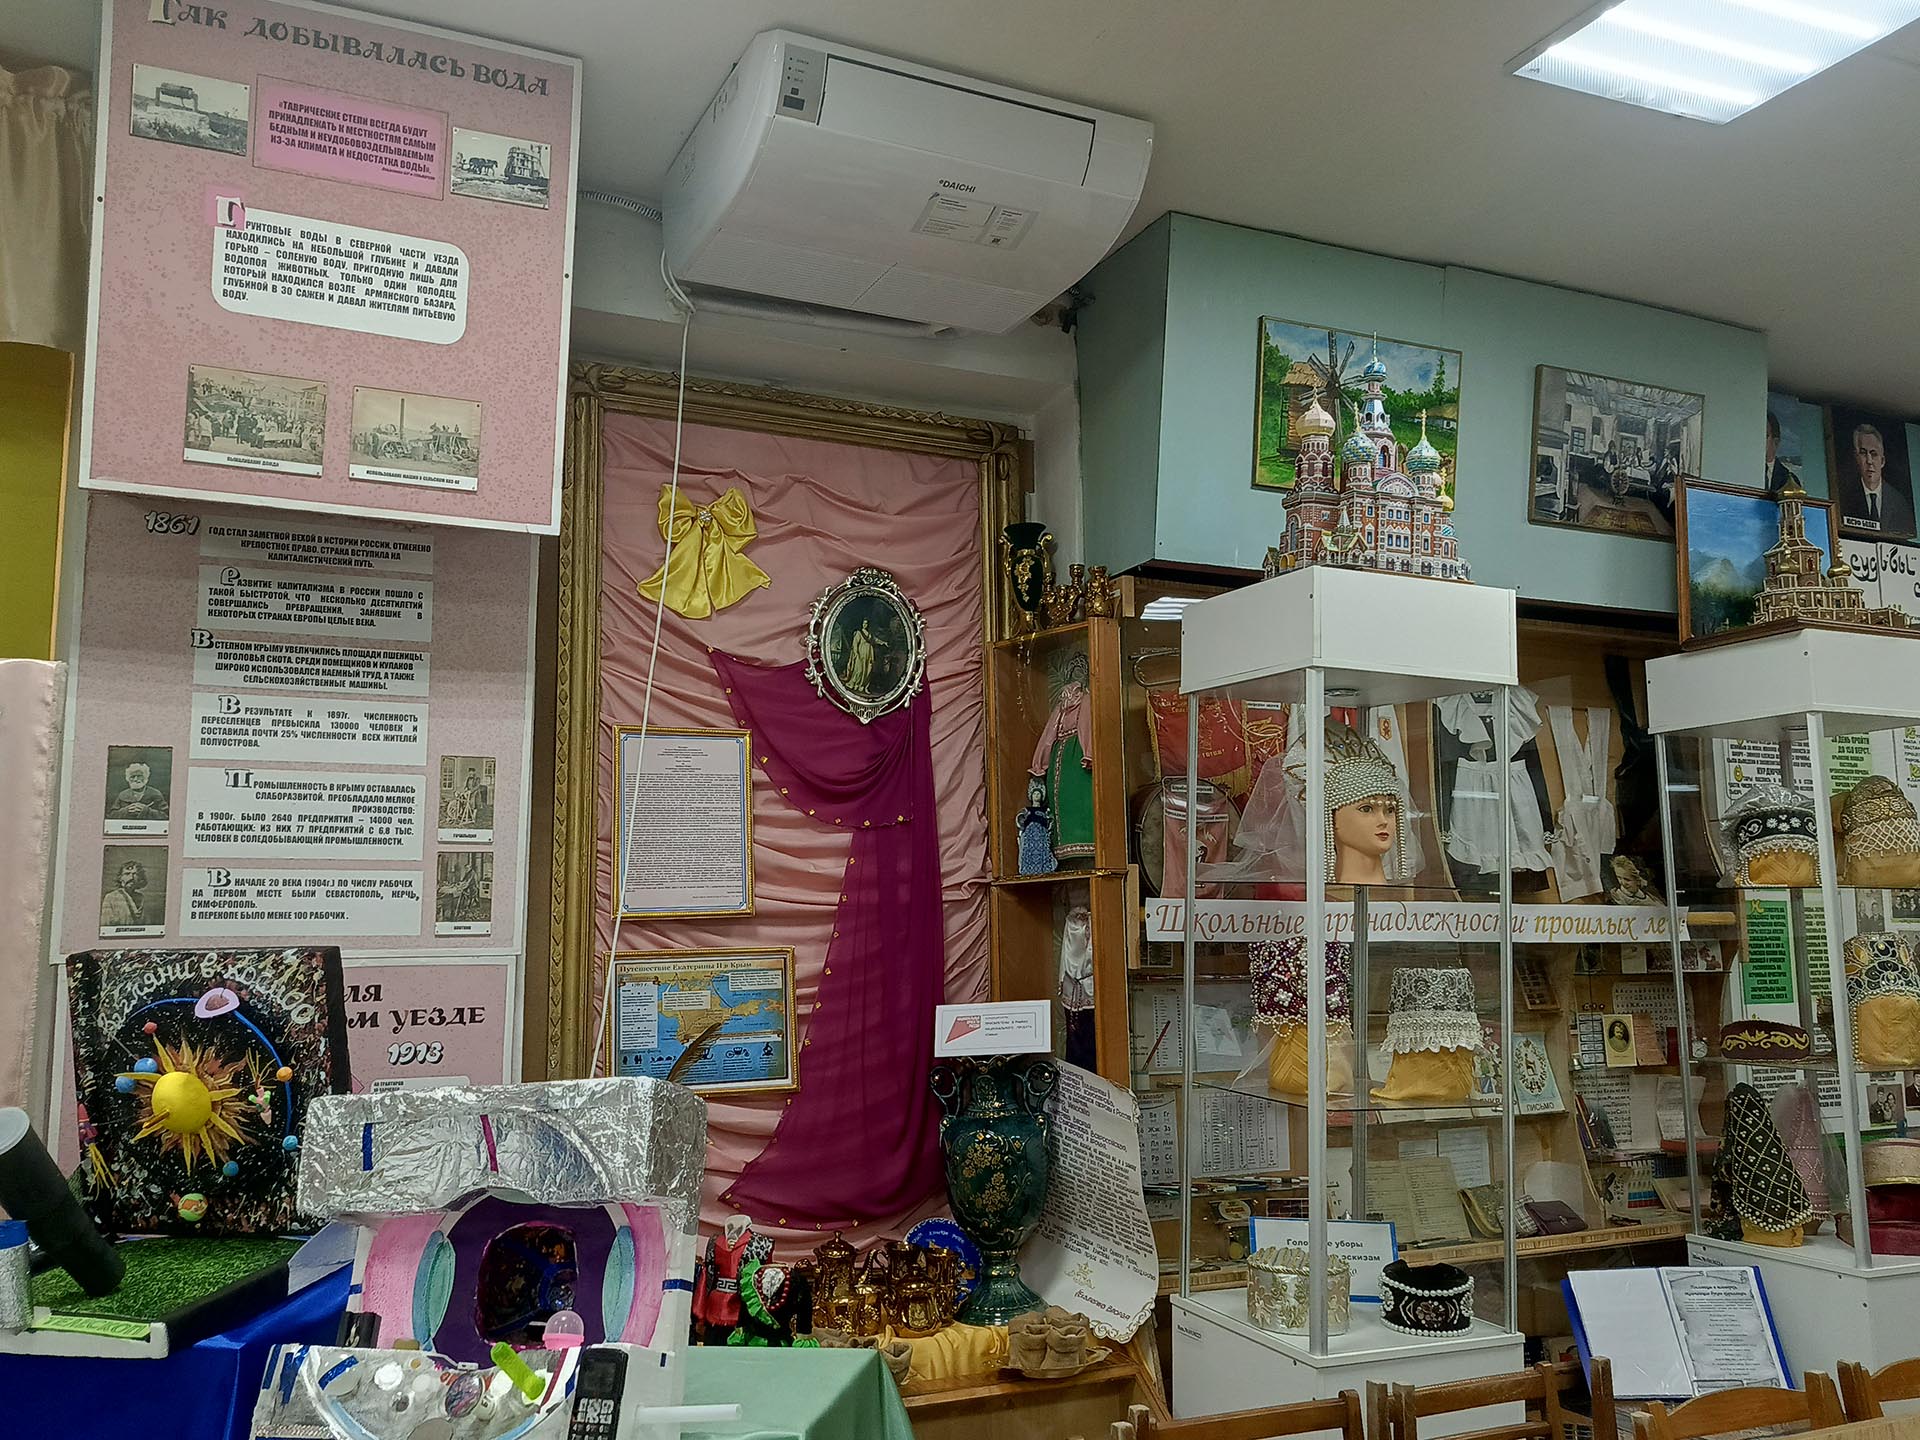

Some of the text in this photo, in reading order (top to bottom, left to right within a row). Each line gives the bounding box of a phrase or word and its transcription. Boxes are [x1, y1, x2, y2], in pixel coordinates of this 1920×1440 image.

[244, 17, 465, 78] ДОБЫВАЛАСЬ
[472, 63, 549, 97] ВОДА
[268, 110, 436, 150] ПРИНАДЛЕЖАТЬ МЕСТНОСТЯМ САМЫМ
[342, 112, 368, 125] СТЕПИ
[369, 118, 400, 132] ВСЕГДА
[402, 125, 428, 137] БУДУТ
[269, 122, 433, 162] БЕДНЫМ НЕУДОБОВОЗДЕЛЫВАЕМЫМ
[270, 134, 296, 147] ИЗ-ЗА
[297, 139, 337, 155] КЛИМАТА
[346, 149, 398, 167] НЕДОСТАТКА
[942, 180, 976, 193] DAICHI
[226, 229, 458, 276] НАХОДИЛИСЬ НА НЕБОЛЬШОЙ ГЛУБИНЕ ДАВАЛИ
[300, 230, 327, 242] ВОДЫ
[349, 238, 391, 253] СЕВЕРНОЙ
[399, 247, 425, 259] ЧАСТИ
[433, 253, 459, 265] УЕЗДА
[224, 241, 258, 254] ГОРЬКО
[276, 249, 317, 264] СОЛЕНУЮ
[353, 262, 404, 278] ПРИГОДНУЮ
[409, 272, 434, 284] ЛИШЬ
[439, 277, 457, 288] ДЛЯ
[224, 253, 266, 270] ВОДОПОЯ
[339, 271, 373, 285] ТОЛЬКО
[383, 279, 406, 290] ОДИН
[222, 288, 248, 300] ВОДУ.
[144, 511, 200, 536] 1861
[267, 552, 374, 568] КАПИТАЛИСТИЧЕСКИЙ ПУТЬ.
[208, 587, 234, 596] ТАКОЙ
[294, 593, 310, 601] ЧТО
[320, 595, 366, 605] НЕСКОЛЬКО
[370, 598, 422, 609] ДЕСЯТИЛЕТИЙ
[277, 581, 334, 593] КАПИТАЛИЗМА
[349, 586, 380, 596] РОССИИ
[384, 589, 413, 599] ПОШЛО
[208, 598, 401, 618] СОВЕРШАЛИСЬ ПРЕВРАЩЕНИЯ, ЗАНЯВШИЕ
[191, 628, 214, 648] В
[214, 641, 252, 650] СТЕПНОМ
[253, 643, 283, 652] КРЫМУ
[284, 645, 340, 656] УВЕЛИЧИЛИСЬ
[342, 648, 381, 659] ПЛОЩАДИ
[243, 674, 346, 687] СЕЛЬСКОХОЗЯЙСТВЕННЫЕ
[218, 695, 418, 722] В РЕЗУЛЬТАТЕ 1897г. ЧИСЛЕННОСТЬ
[200, 726, 417, 742] СОСТАВИЛА ПОЧТИ 25% ЧИСЛЕННОСТИ ВСЕХ ЖИТЕЛЕЙ
[201, 716, 403, 732] ПЕРЕСЕЛЕНЦЕВ ПРЕВЫСИЛА 130000 ЧЕЛОВЕК
[200, 737, 260, 747] ПОЛУОСТРОВА.
[336, 783, 365, 792] КРЫМУ
[366, 784, 415, 793] ОСТАВАЛАСЬ
[327, 793, 384, 803] ПРЕОБЛАДАЛО
[385, 795, 415, 804] МЕЛКОЕ
[209, 812, 235, 820] 1900г.
[240, 812, 266, 821] БЫЛО
[271, 813, 292, 821] 2640
[297, 814, 353, 823] ПРЕДПРИЯТИЯ
[369, 816, 392, 824] 14000
[351, 805, 415, 814] ПРОИЗВОДСТВО:
[194, 834, 231, 842] ЧЕЛОВЕК
[324, 836, 403, 845] ПРОМЫШЛЕННОСТИ.
[207, 867, 232, 888] В
[234, 878, 266, 886] НАЧАЛЕ
[268, 878, 279, 886] 20
[282, 878, 302, 886] ВЕКА
[337, 879, 348, 887] ПО
[350, 879, 377, 887] ЧИСЛУ
[379, 879, 412, 887] РАБОЧЕХ
[191, 888, 420, 900] НА ПЕРВОМ МЕСТЕ БЫЛИ СЕВАСТОПОЛЬ, КЕРЧЬ,
[191, 900, 257, 908] СИМФЕРОПОЛЬ.
[1534, 915, 1638, 941] прошлых
[388, 1006, 486, 1034] УЕЗДЕ
[387, 1041, 444, 1066] 1913
[1287, 1239, 1363, 1248] Голое уборы
